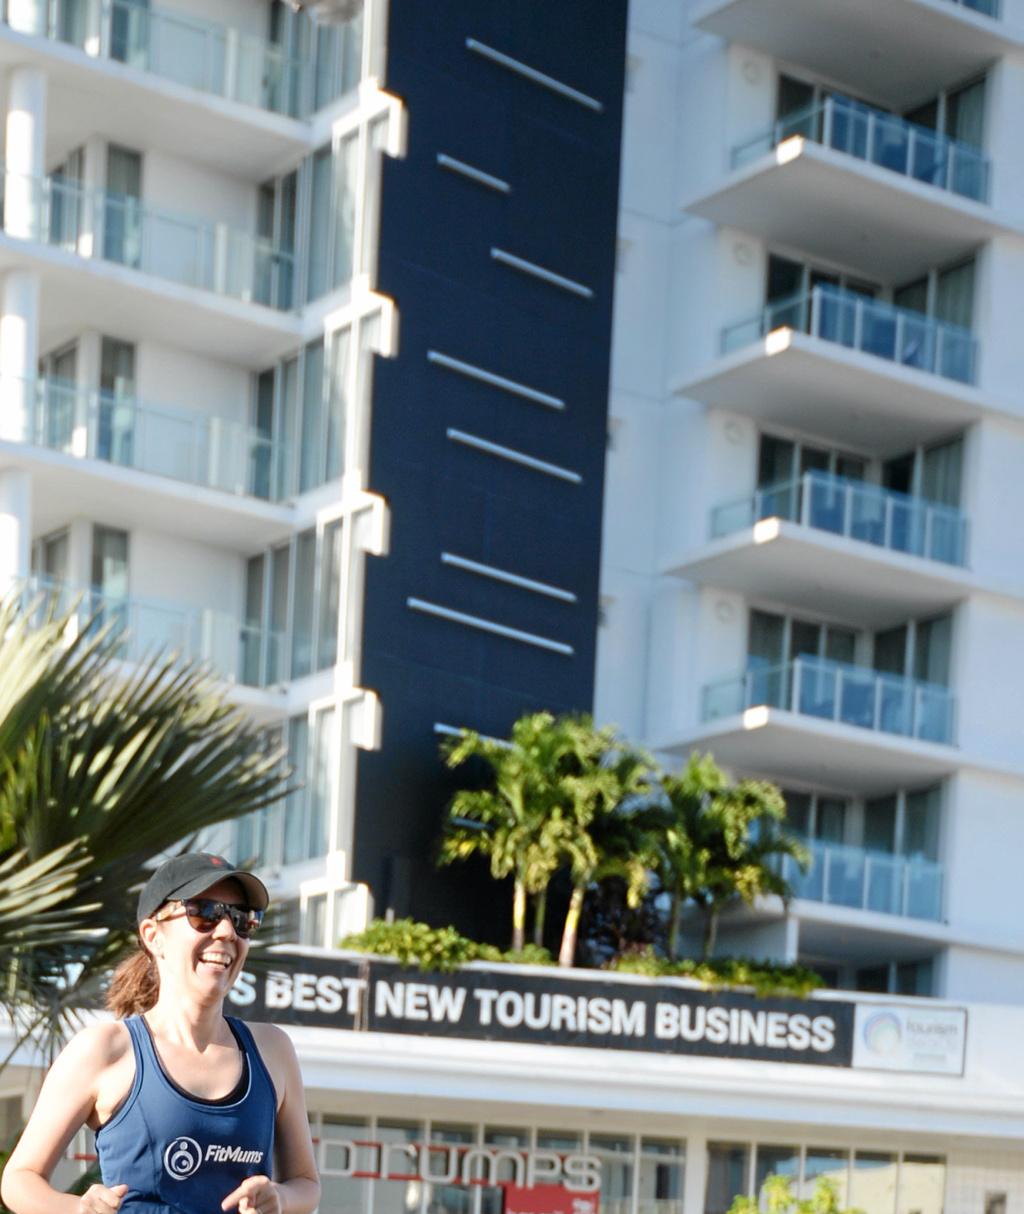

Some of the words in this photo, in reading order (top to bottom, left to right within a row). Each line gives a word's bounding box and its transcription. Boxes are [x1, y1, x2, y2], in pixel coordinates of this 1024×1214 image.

[265, 971, 367, 1014] BEST
[375, 980, 466, 1023] NEW
[473, 987, 646, 1037] TOURISM
[654, 1002, 836, 1052] BUSINESS
[205, 1145, 264, 1164] FitMums
